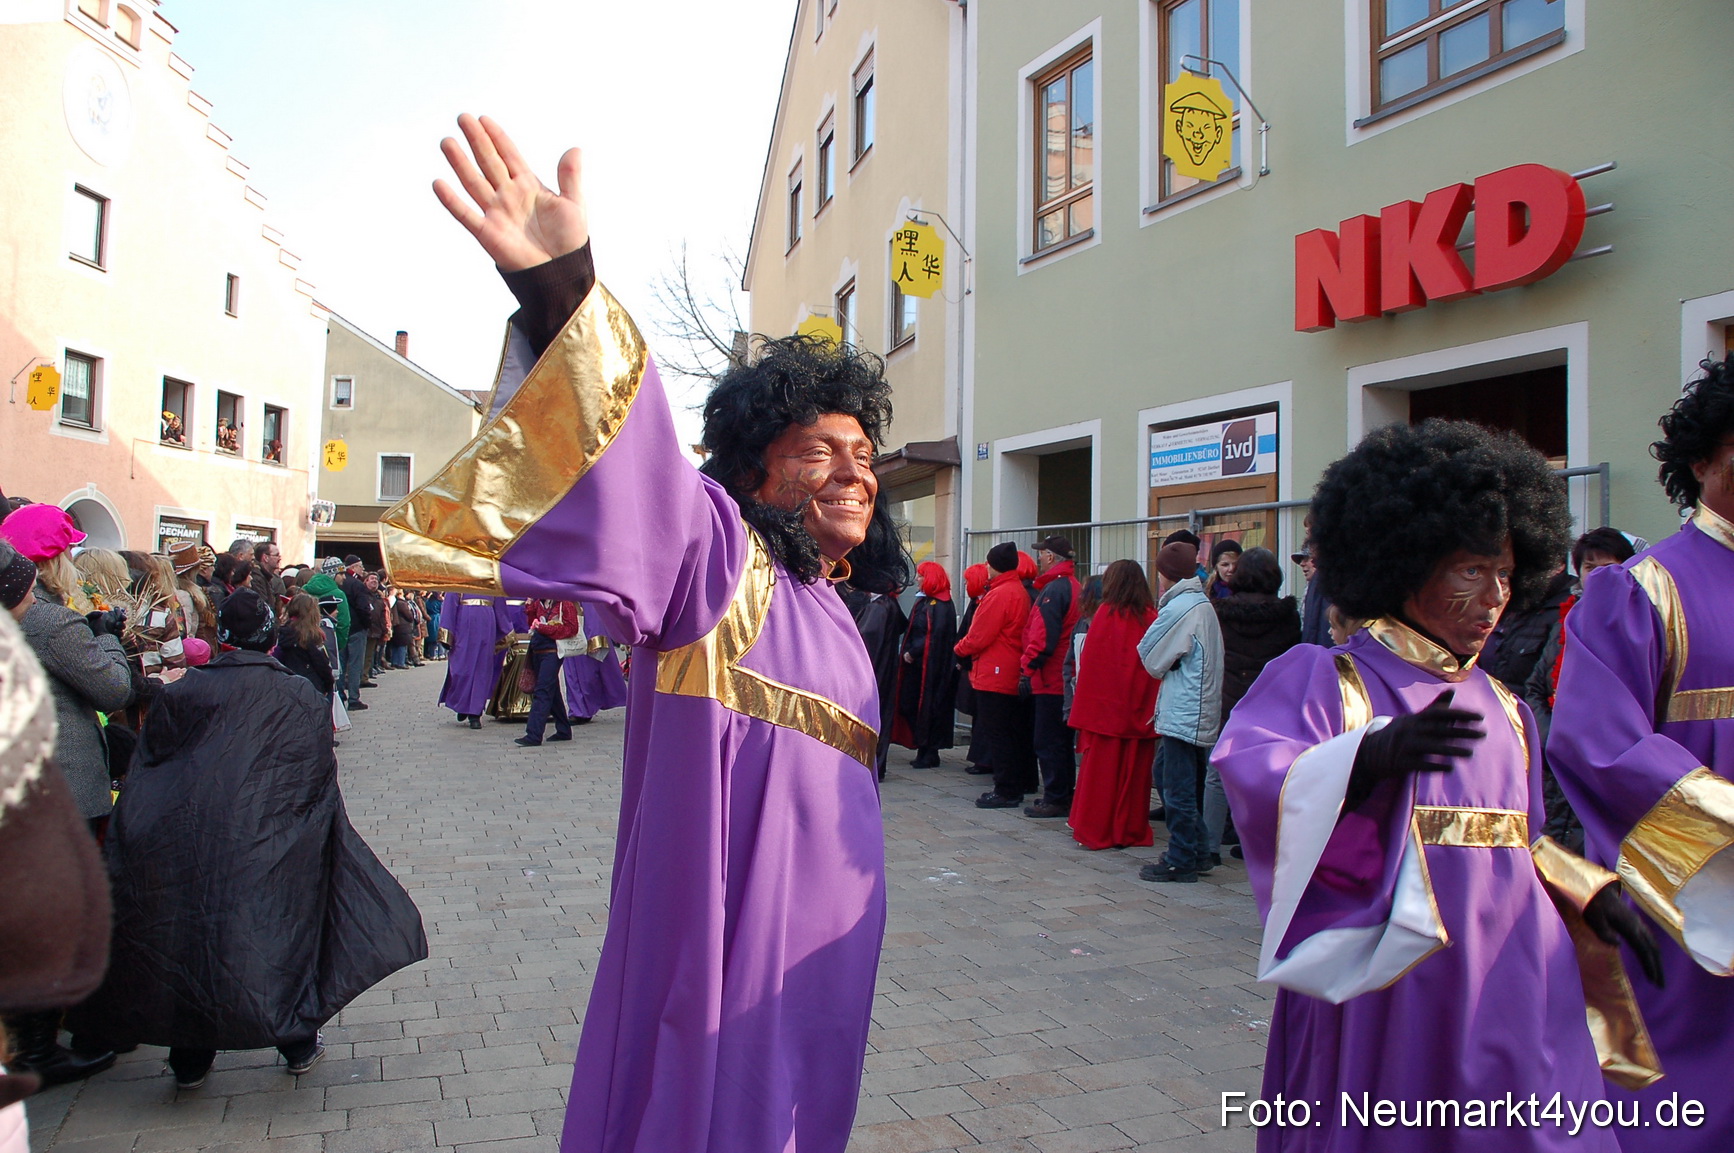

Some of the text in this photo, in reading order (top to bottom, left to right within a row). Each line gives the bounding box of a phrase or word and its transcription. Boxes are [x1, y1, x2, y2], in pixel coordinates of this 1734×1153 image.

[1295, 163, 1586, 333] NKD
[898, 261, 914, 282] 人
[922, 254, 940, 280] 华
[1152, 447, 1219, 466] IMMOBILIENBÜRO
[1225, 435, 1253, 460] ivd
[160, 526, 200, 538] DECHANT
